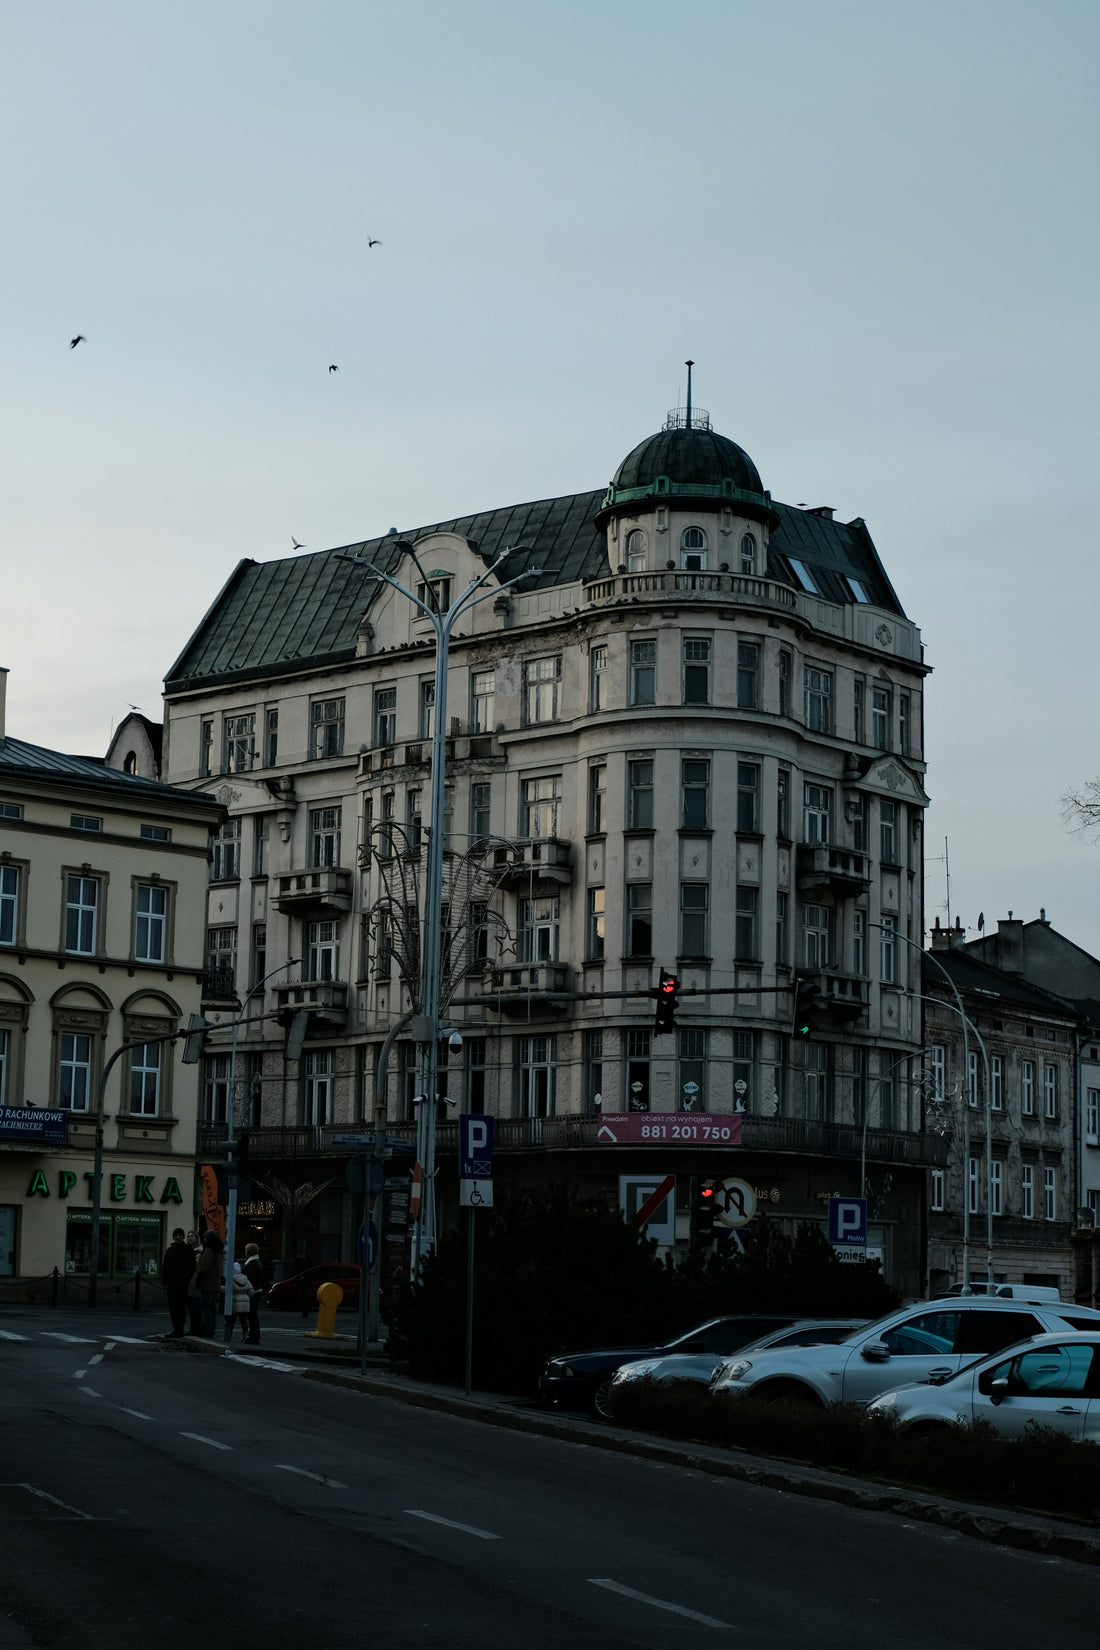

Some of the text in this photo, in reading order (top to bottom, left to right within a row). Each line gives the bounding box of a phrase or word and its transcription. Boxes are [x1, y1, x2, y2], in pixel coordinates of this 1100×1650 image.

[5, 1109, 64, 1122] RACHUNKOWE
[677, 1116, 713, 1124] wynajem
[468, 1120, 487, 1159] P
[641, 1125, 731, 1140] 881 201 750
[26, 1169, 183, 1204] APTEKA
[755, 1186, 769, 1199] lus
[837, 1202, 861, 1239] P
